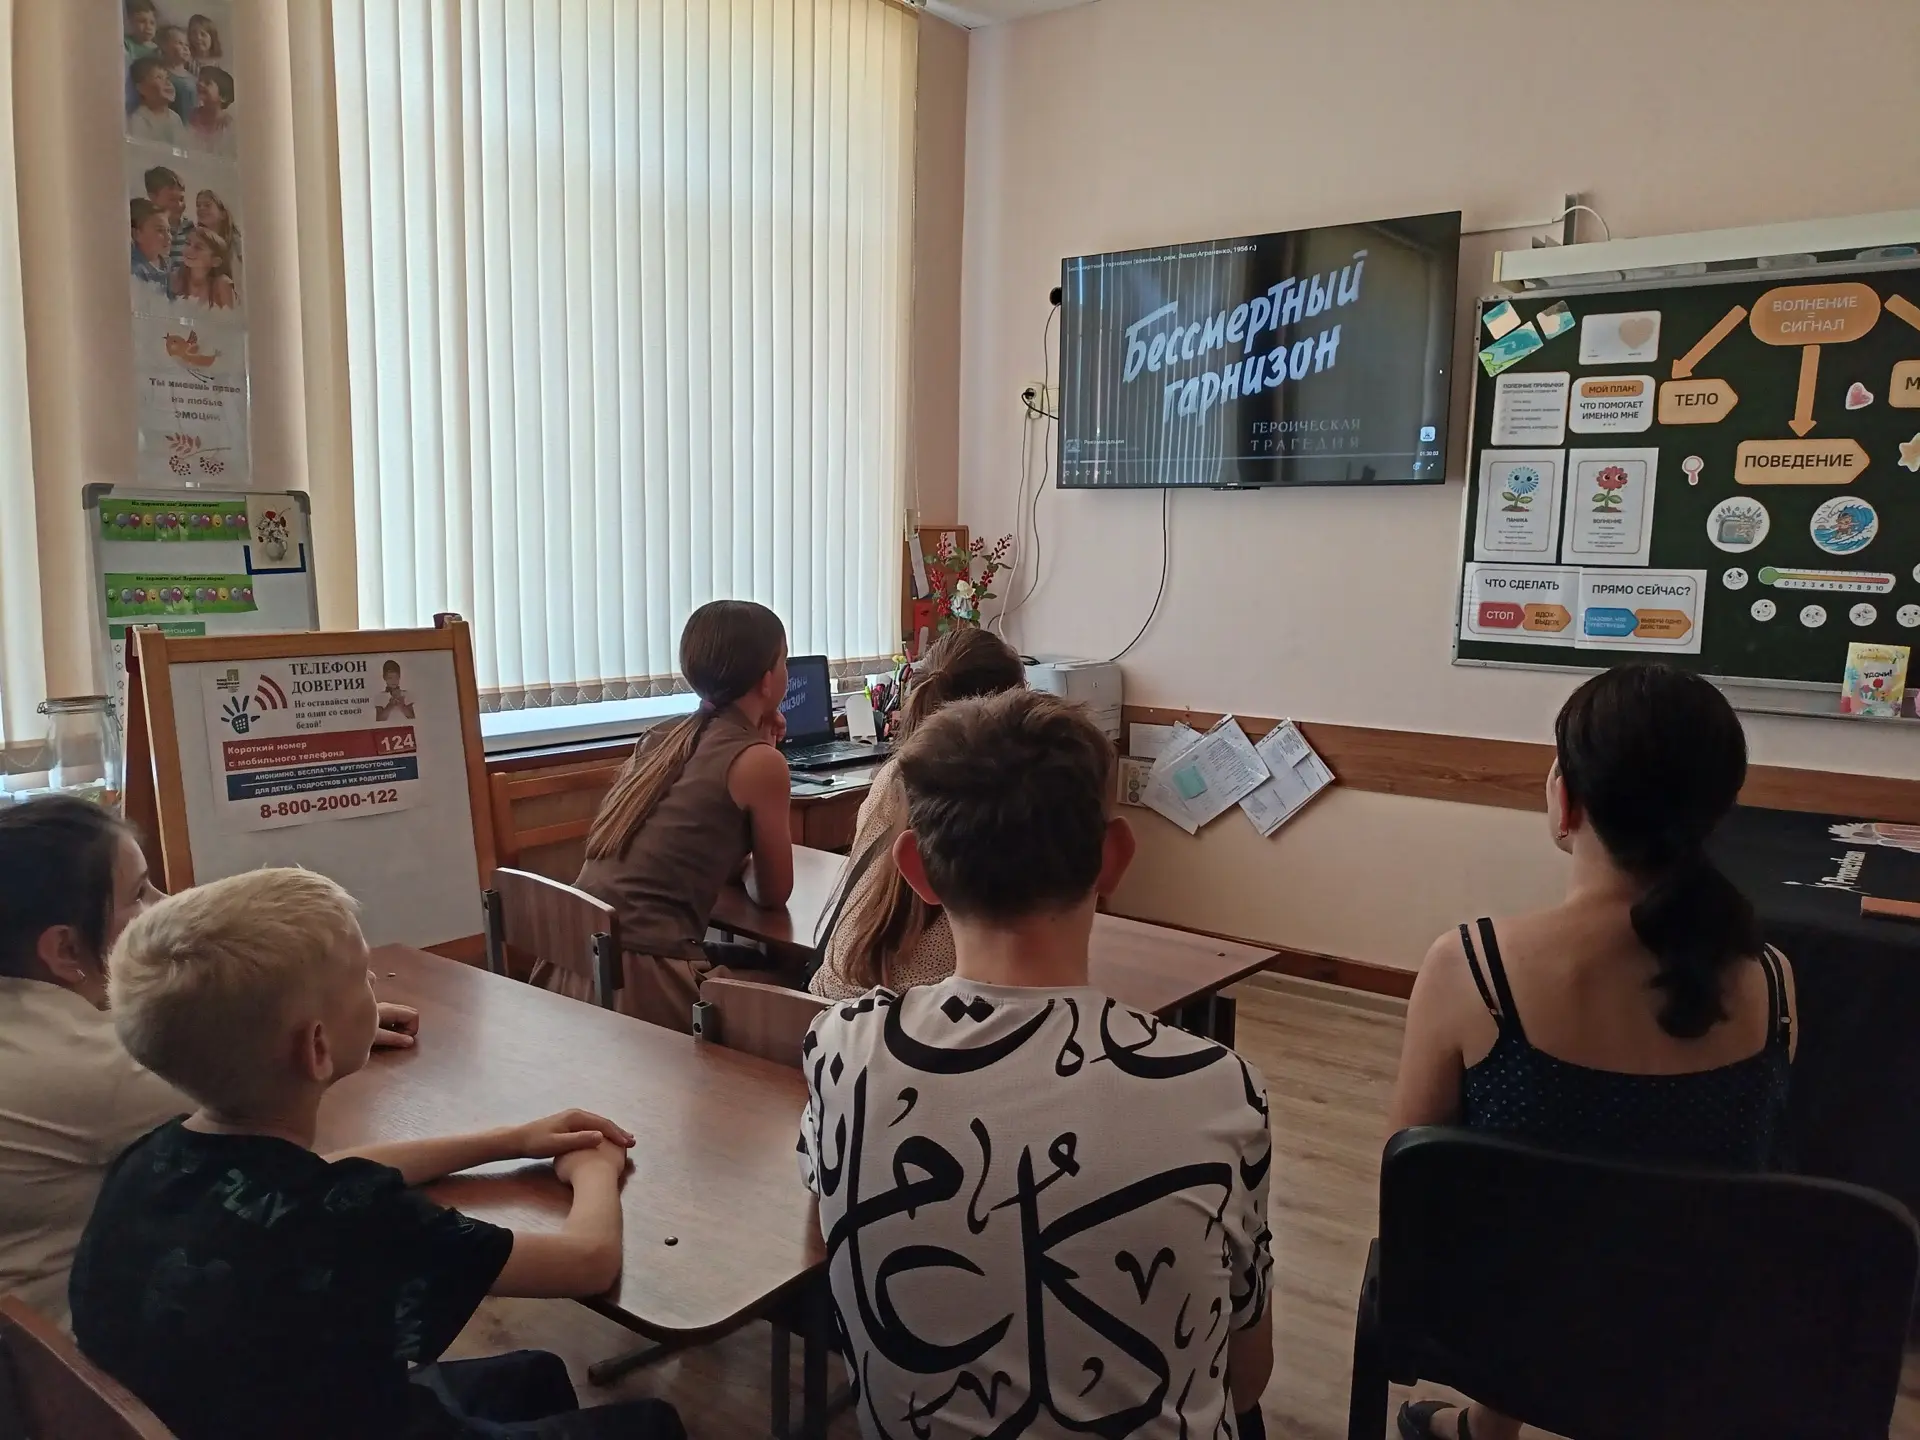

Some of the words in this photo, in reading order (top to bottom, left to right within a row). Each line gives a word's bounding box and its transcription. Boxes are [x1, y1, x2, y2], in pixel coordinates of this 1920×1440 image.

[1772, 296, 1858, 312] ВОЛНЕНИЕ
[1123, 250, 1368, 382] Бессмертный
[1780, 318, 1845, 333] СИГНАЛ
[1163, 324, 1342, 427] гарнизон
[149, 377, 166, 386] Ты
[168, 380, 210, 391] имеешь
[212, 385, 241, 394] право
[1588, 384, 1609, 394] МОЙ
[1610, 383, 1637, 393] ПЛАН:
[1579, 402, 1598, 410] ЧТО
[1599, 400, 1644, 410] ПОМОГАЕТ
[1674, 392, 1719, 406] ТЕЛО
[1582, 411, 1619, 420] ИМЕННО
[1620, 411, 1639, 419] МНЕ
[1252, 418, 1361, 434] ГЕРОИЧЕСКАЯ
[1251, 436, 1360, 451] ТРАГЕДИЯ
[1744, 453, 1854, 469] ПОВЕДЕНИЕ
[1485, 578, 1506, 588] ЧТО
[1509, 579, 1560, 591] СДЕЛАТЬ
[1592, 584, 1633, 595] ПРЯМО
[1636, 584, 1691, 596] СЕЙЧАС?
[1486, 610, 1514, 620] СТОП
[289, 660, 367, 676] ТЕЛЕФОН
[292, 678, 365, 694] ДОВЕРИЯ
[294, 700, 306, 708] Не
[307, 698, 349, 707] оставайся
[227, 744, 274, 755] Короткий
[276, 741, 307, 751] номер
[381, 733, 415, 751] 124
[237, 754, 297, 767] мобильного
[299, 750, 345, 761] телефона
[340, 760, 394, 772] КРУГЛОСУТОЧНО
[255, 787, 270, 796] ДЛЯ
[271, 783, 296, 794] ДЕТЕЙ,
[296, 780, 342, 790] ПОДРОСТКОВ
[359, 772, 397, 783] РОДИТЕЛЕЙ
[260, 788, 398, 819] 8-800-2000-122
